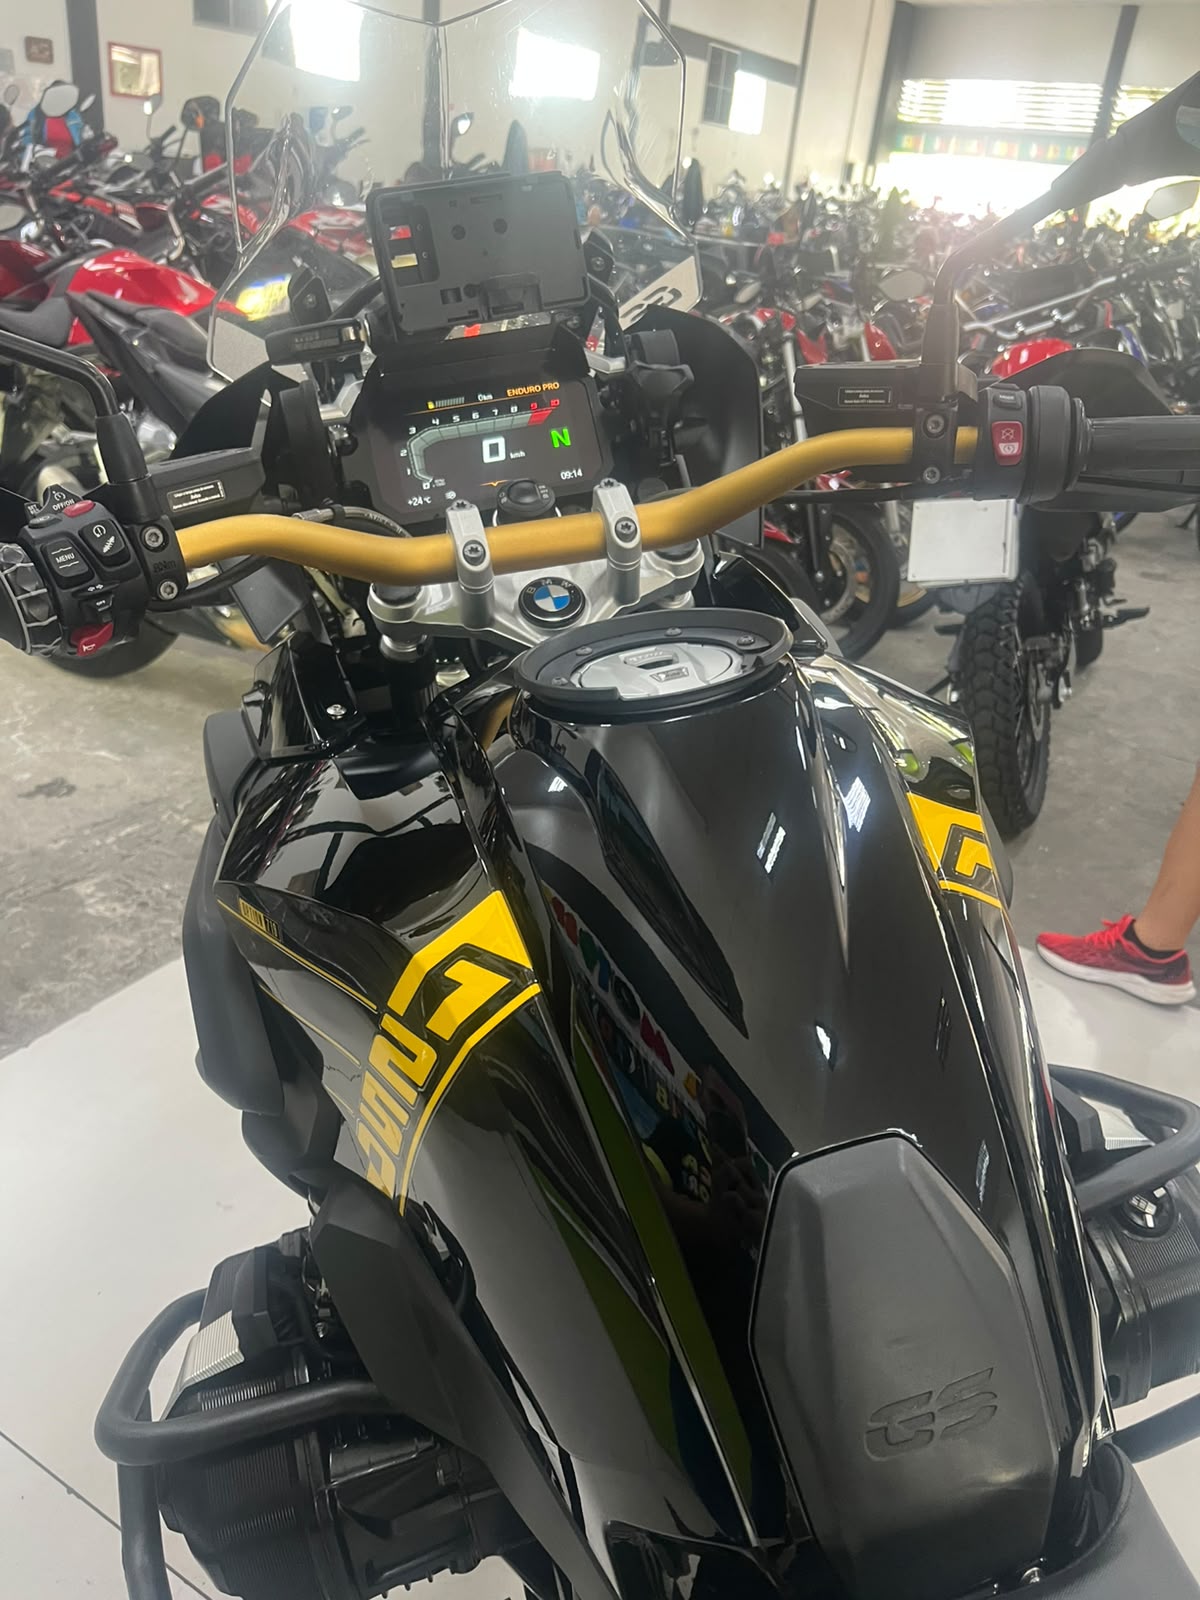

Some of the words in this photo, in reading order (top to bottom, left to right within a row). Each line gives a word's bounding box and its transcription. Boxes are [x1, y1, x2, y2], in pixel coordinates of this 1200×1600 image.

[507, 385, 541, 397] ENDURO
[542, 382, 560, 393] PRO
[432, 418, 440, 426] 4
[452, 415, 461, 423] 5
[472, 412, 480, 420] 6
[408, 426, 417, 435] 3
[550, 428, 571, 448] N
[400, 449, 407, 457] 2
[482, 435, 506, 463] 0
[560, 468, 583, 480] 09:14
[52, 499, 75, 511] OFF/ON
[55, 552, 75, 564] MENU
[864, 1367, 998, 1461] GS
